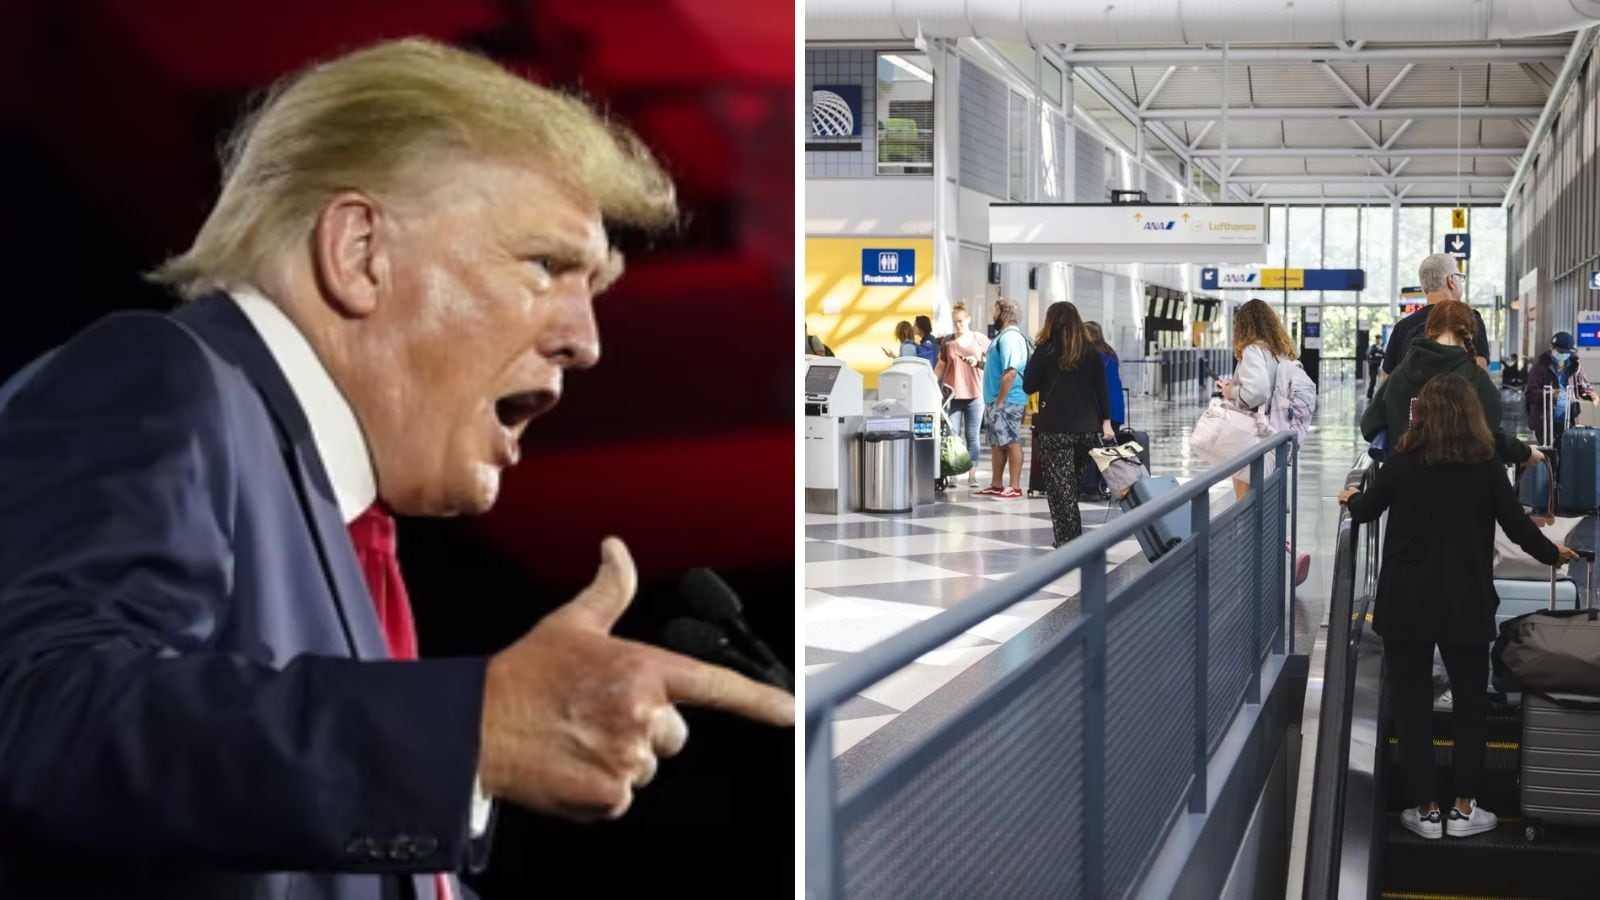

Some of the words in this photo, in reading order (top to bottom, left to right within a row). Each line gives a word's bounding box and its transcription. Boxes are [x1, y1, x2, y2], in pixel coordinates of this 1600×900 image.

[1144, 222, 1166, 230] ANA
[1208, 222, 1257, 231] Lufthansa
[864, 275, 904, 283] Restrooms
[1223, 274, 1246, 282] ANA
